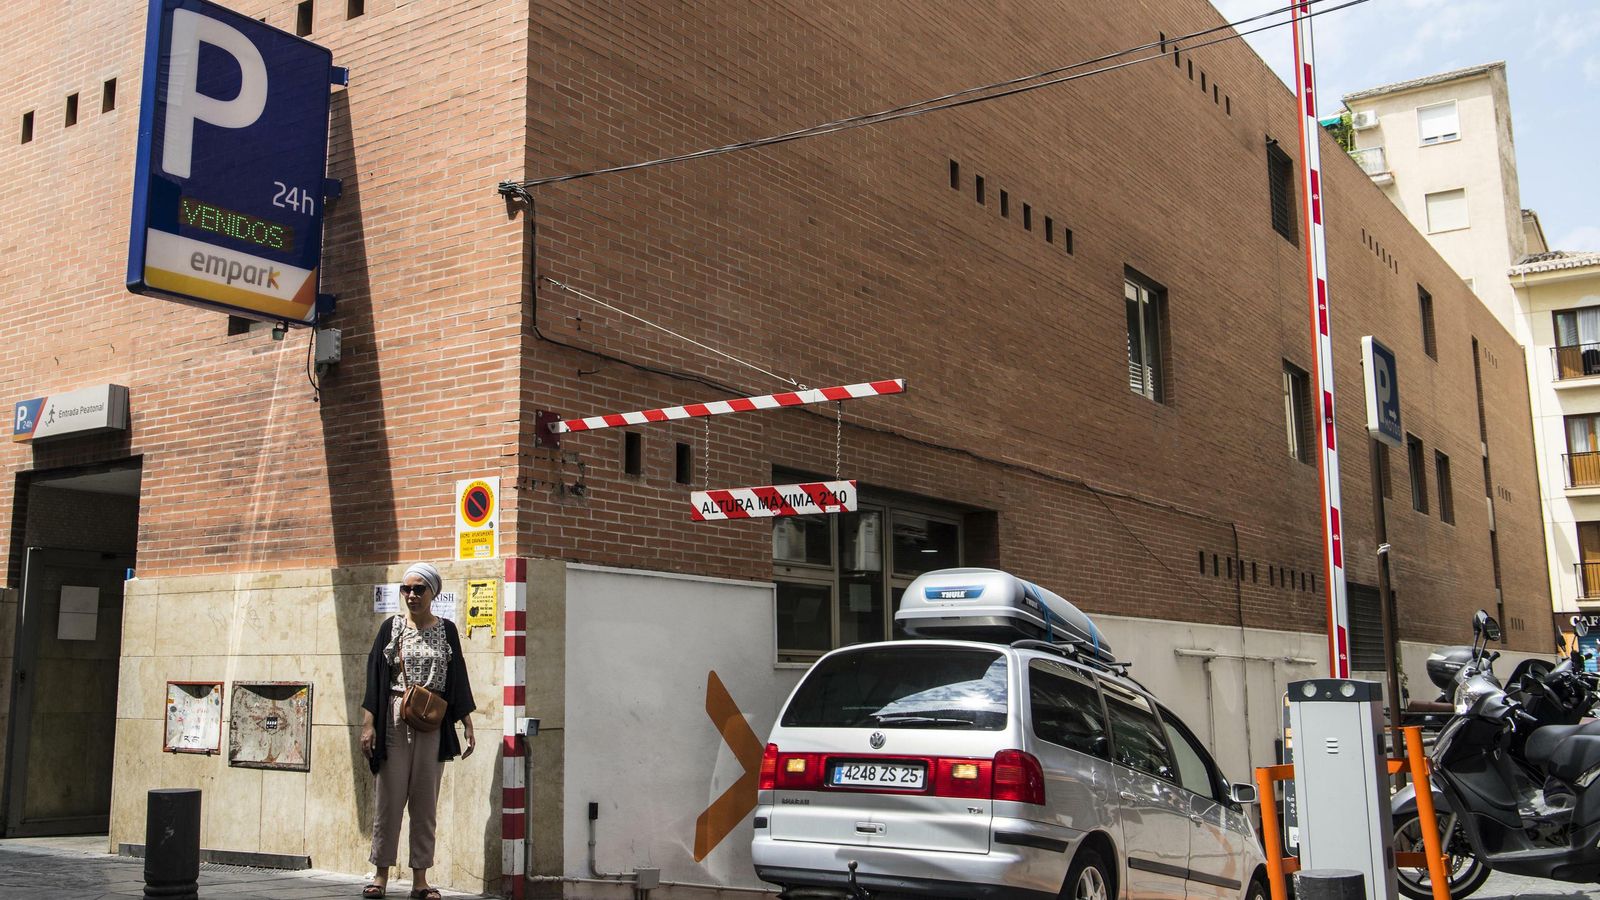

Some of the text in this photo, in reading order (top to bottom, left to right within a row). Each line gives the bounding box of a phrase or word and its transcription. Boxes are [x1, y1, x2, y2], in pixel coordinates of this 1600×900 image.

[162, 8, 268, 179] P
[272, 181, 315, 217] 24h
[183, 200, 284, 248] VENIDOS
[190, 251, 281, 290] empark
[1374, 352, 1391, 423] P
[16, 405, 28, 430] P
[58, 402, 104, 419] Entrada Peatonal
[22, 419, 33, 429] 24h
[702, 490, 847, 514] ALTURA MÁXIMA 2'10
[941, 590, 966, 599] THULE
[844, 765, 919, 783] 4248 ZS 25
